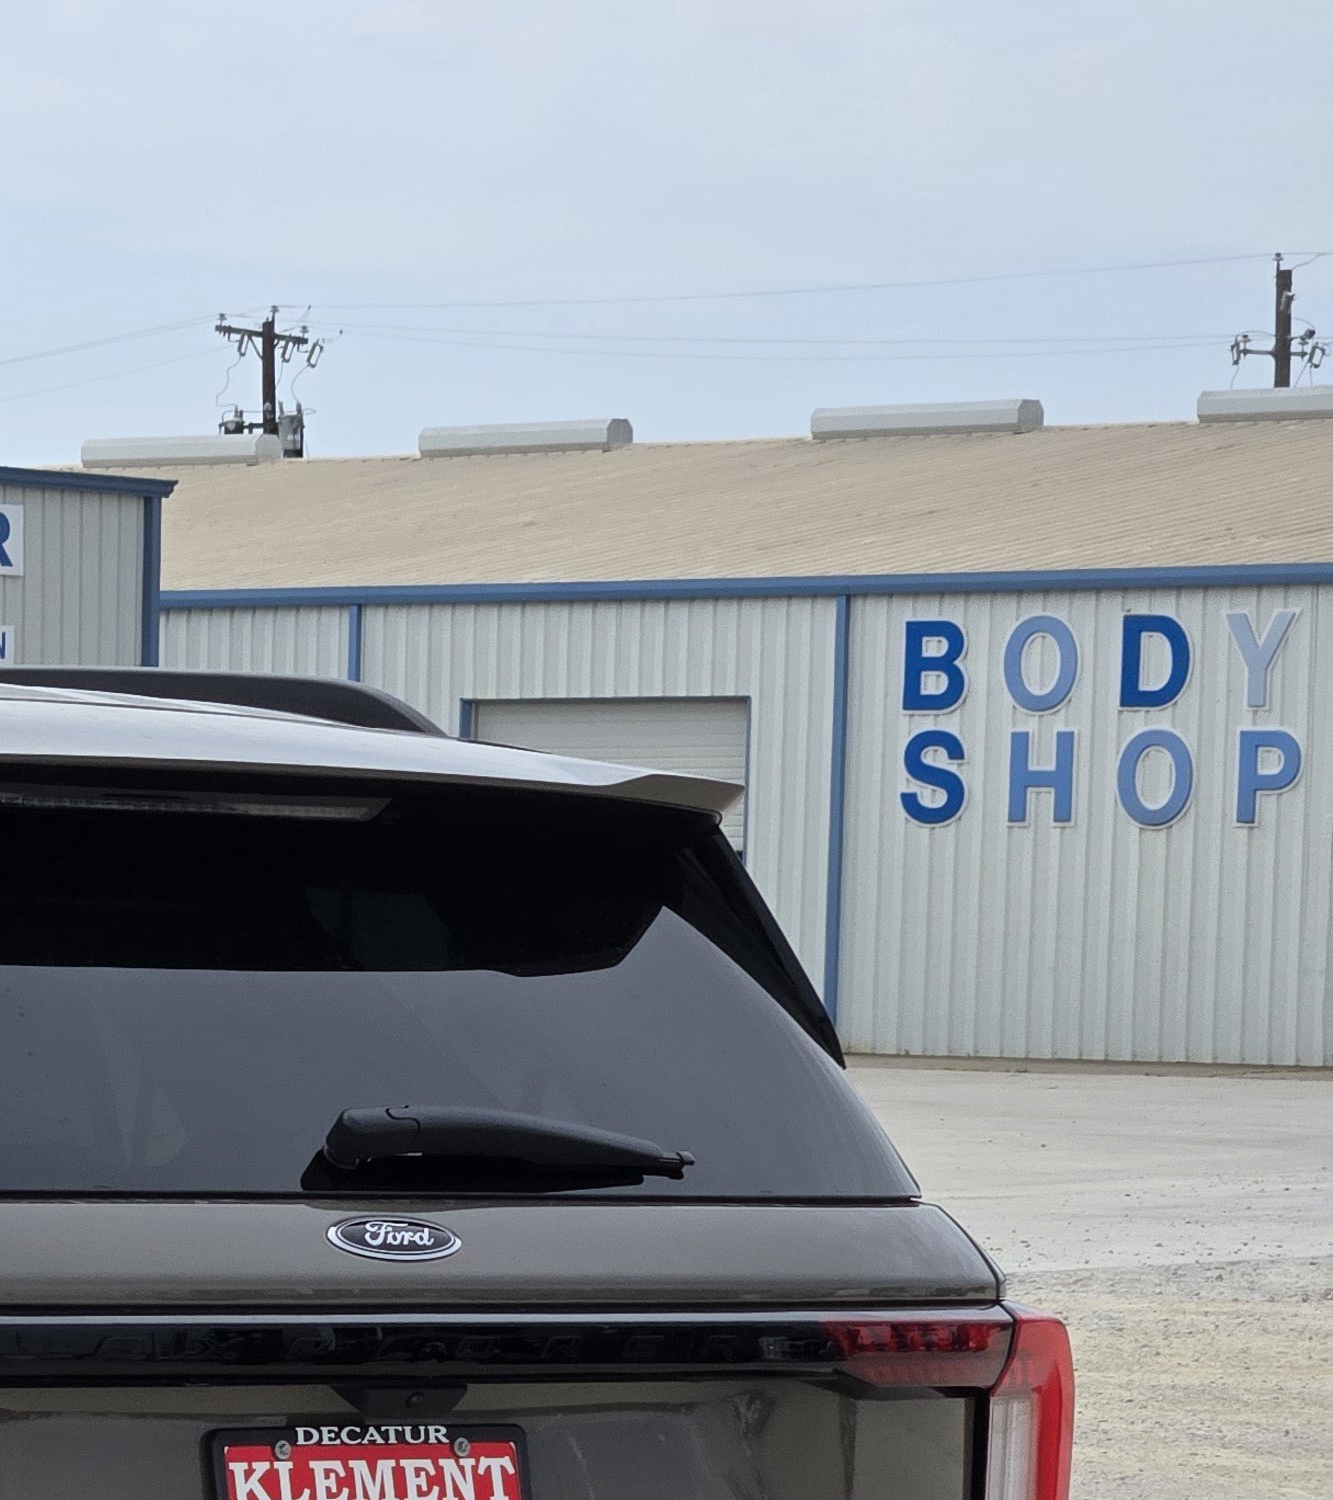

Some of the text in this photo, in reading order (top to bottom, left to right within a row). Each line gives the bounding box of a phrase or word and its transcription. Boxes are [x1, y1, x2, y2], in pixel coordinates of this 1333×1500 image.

[901, 611, 1297, 712] BODY
[899, 728, 1302, 827] SHOP
[364, 1221, 435, 1247] Ford
[295, 1425, 450, 1445] DECATUR
